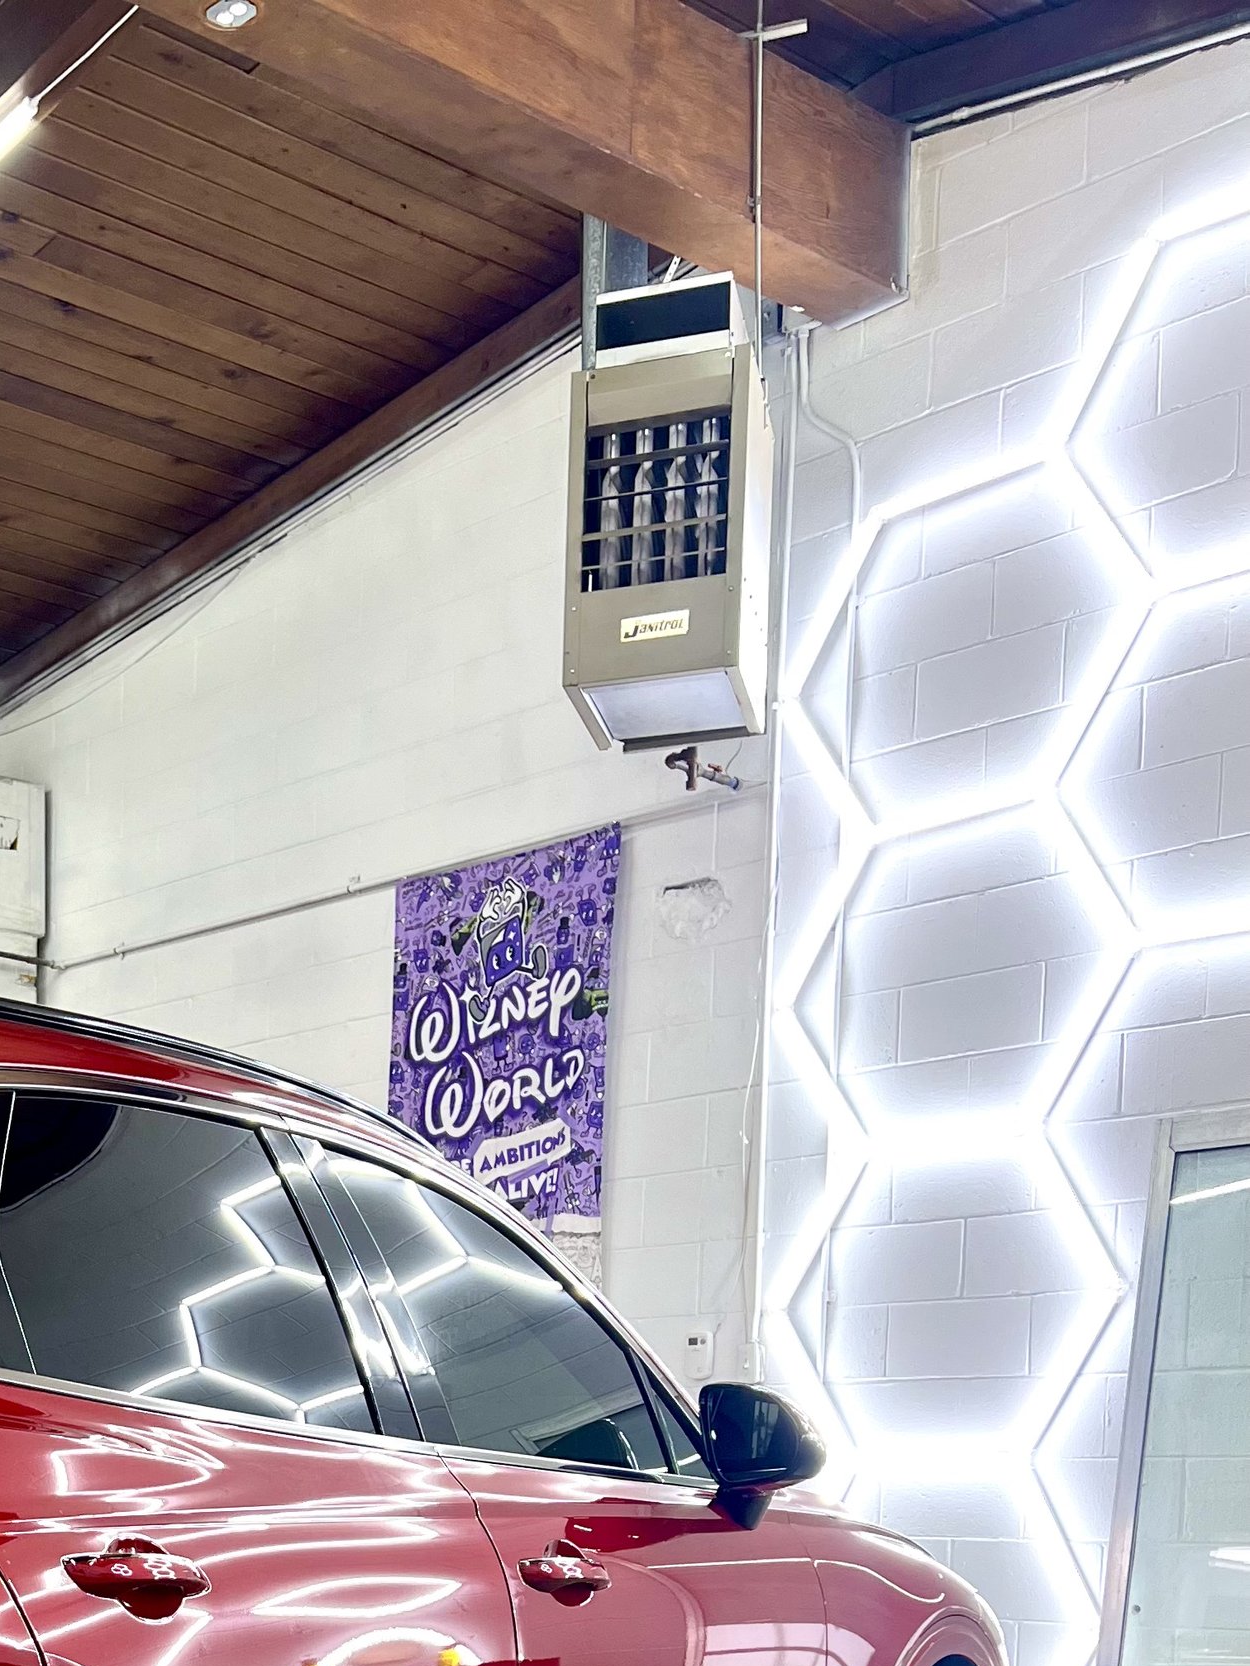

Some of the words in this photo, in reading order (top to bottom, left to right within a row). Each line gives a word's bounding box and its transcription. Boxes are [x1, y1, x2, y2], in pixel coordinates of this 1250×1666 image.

[425, 1048, 585, 1137] WORLD
[479, 1129, 566, 1173] AMBITIONS
[493, 1167, 559, 1201] ALIVE!
